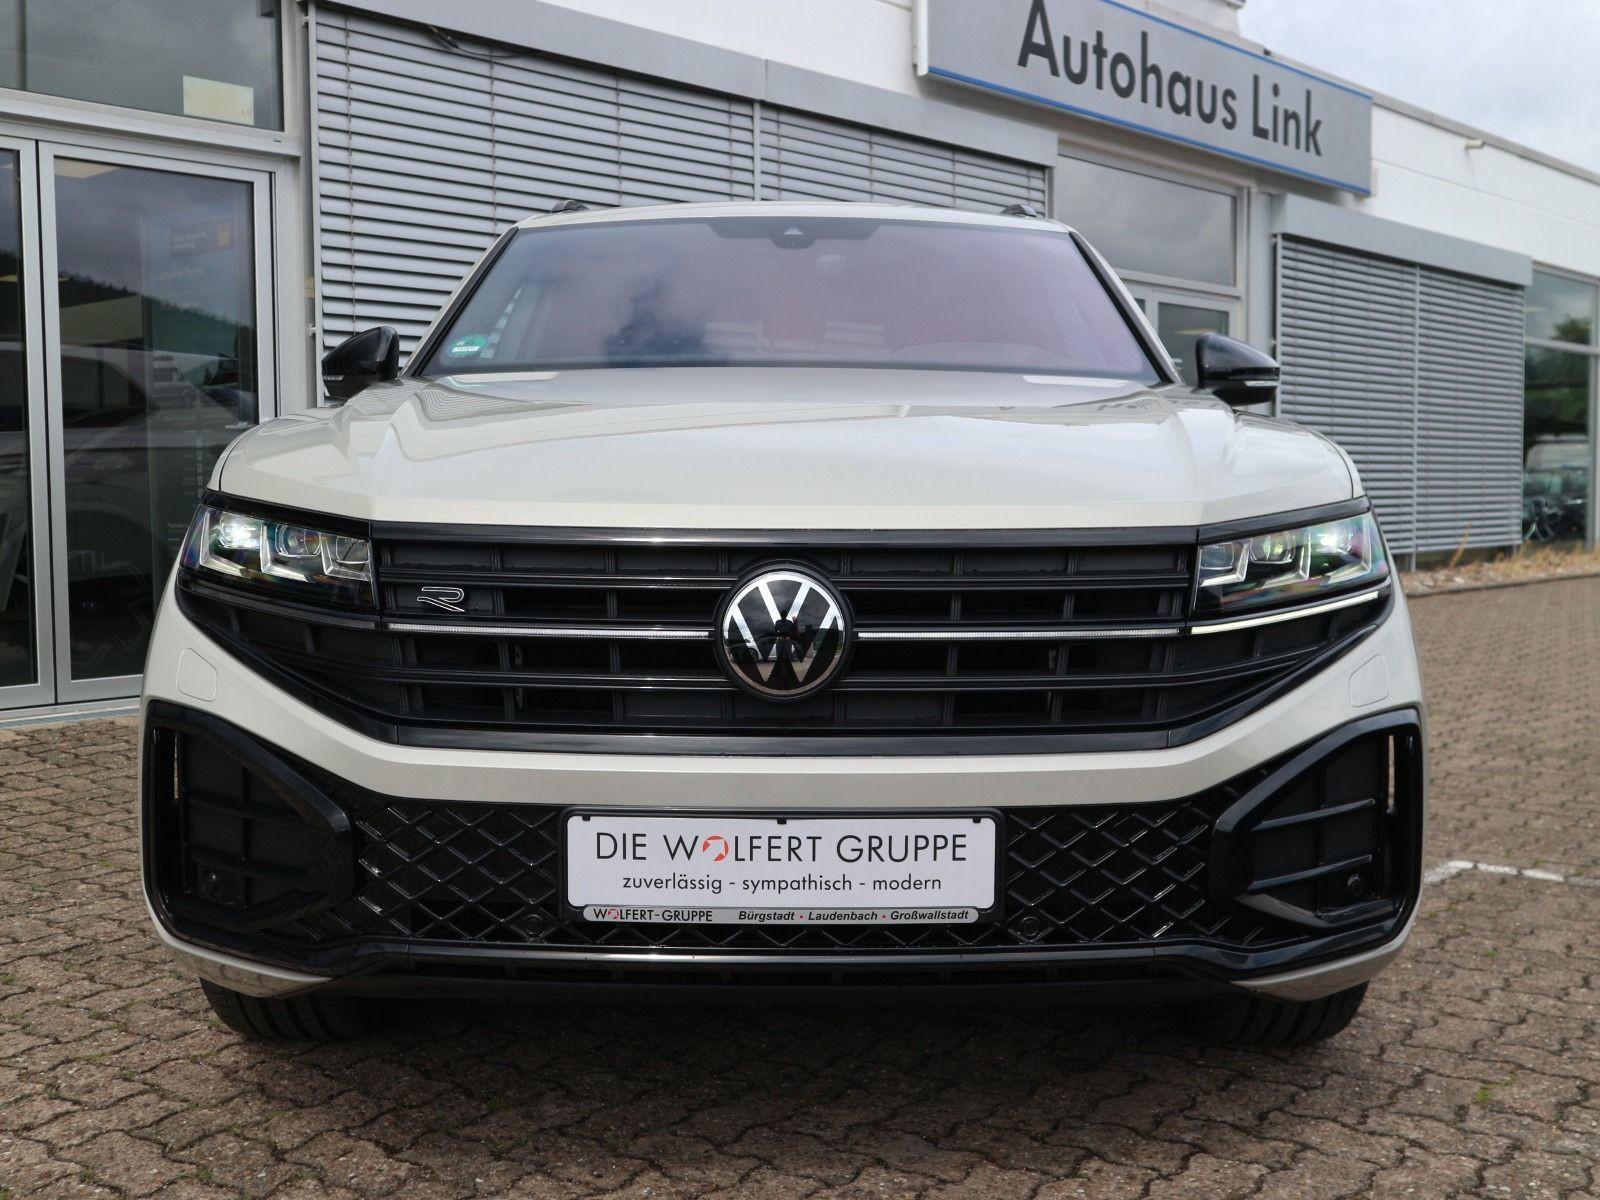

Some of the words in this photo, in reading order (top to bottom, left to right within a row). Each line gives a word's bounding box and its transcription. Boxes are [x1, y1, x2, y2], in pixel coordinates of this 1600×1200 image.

[1017, 0, 1237, 130] Autohaus
[1252, 74, 1323, 157] Link
[596, 832, 647, 860] DIE
[663, 834, 822, 862] WOLFERT
[836, 834, 966, 863] GRUPPE
[622, 872, 722, 894] zuverlässig
[742, 873, 852, 894] sympathisch
[872, 873, 942, 890] modern
[738, 910, 795, 922] Bürgstadt
[808, 911, 878, 921] Laudenbach
[890, 910, 969, 921] Großwallstadt
